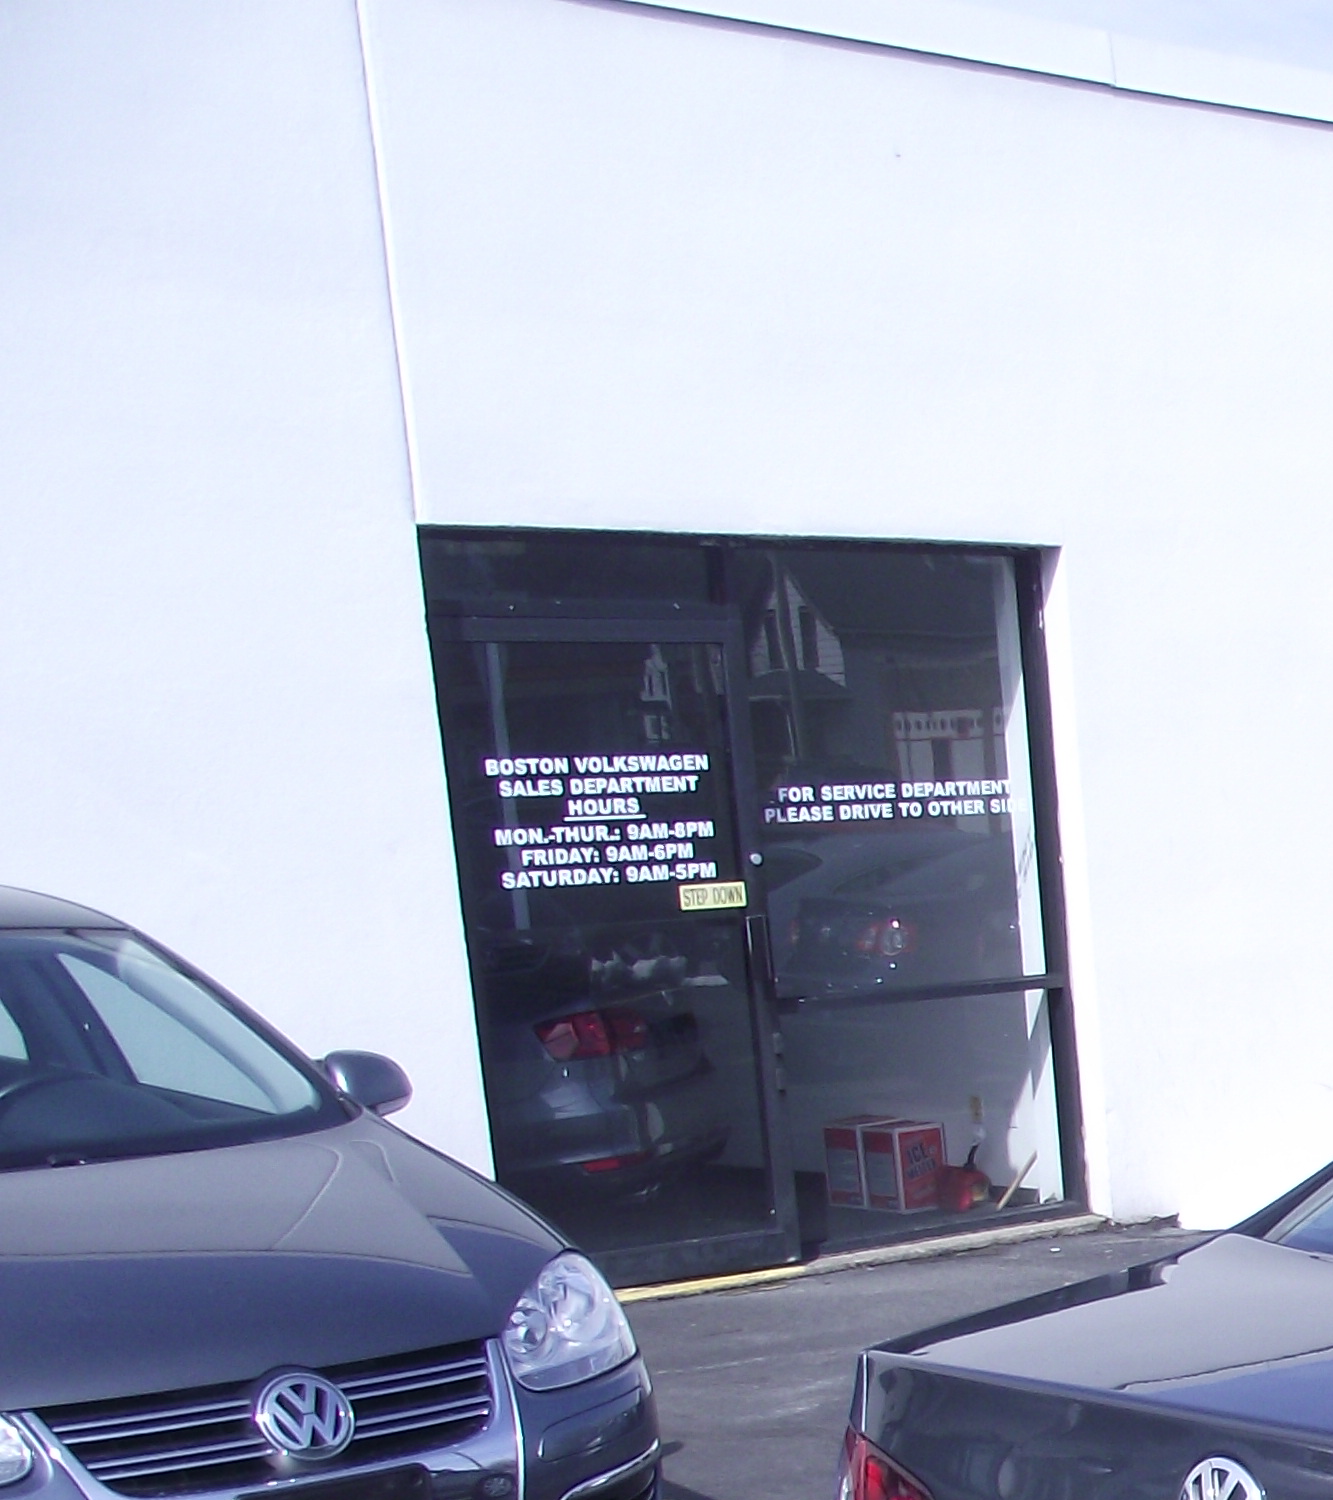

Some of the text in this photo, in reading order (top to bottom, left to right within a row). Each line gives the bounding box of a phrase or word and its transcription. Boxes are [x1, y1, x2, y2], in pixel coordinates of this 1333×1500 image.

[485, 754, 709, 776] BOSTON VOLKSWAGEN
[499, 775, 698, 797] SALES DEPARTMENT
[778, 779, 1010, 802] FOR SERVICE DEPARTMENT
[567, 798, 640, 815] HOURS
[764, 805, 834, 823] PLEASE
[839, 803, 893, 820] DRIVE
[898, 801, 923, 817] TO
[927, 800, 985, 816] OTHER
[627, 821, 714, 841] 9AM-8PM
[521, 843, 694, 866] FRIDAY: 9AM-6PM
[501, 862, 717, 889] SATURDAY: 9AM-5PM
[683, 886, 743, 907] STEP DOWN
